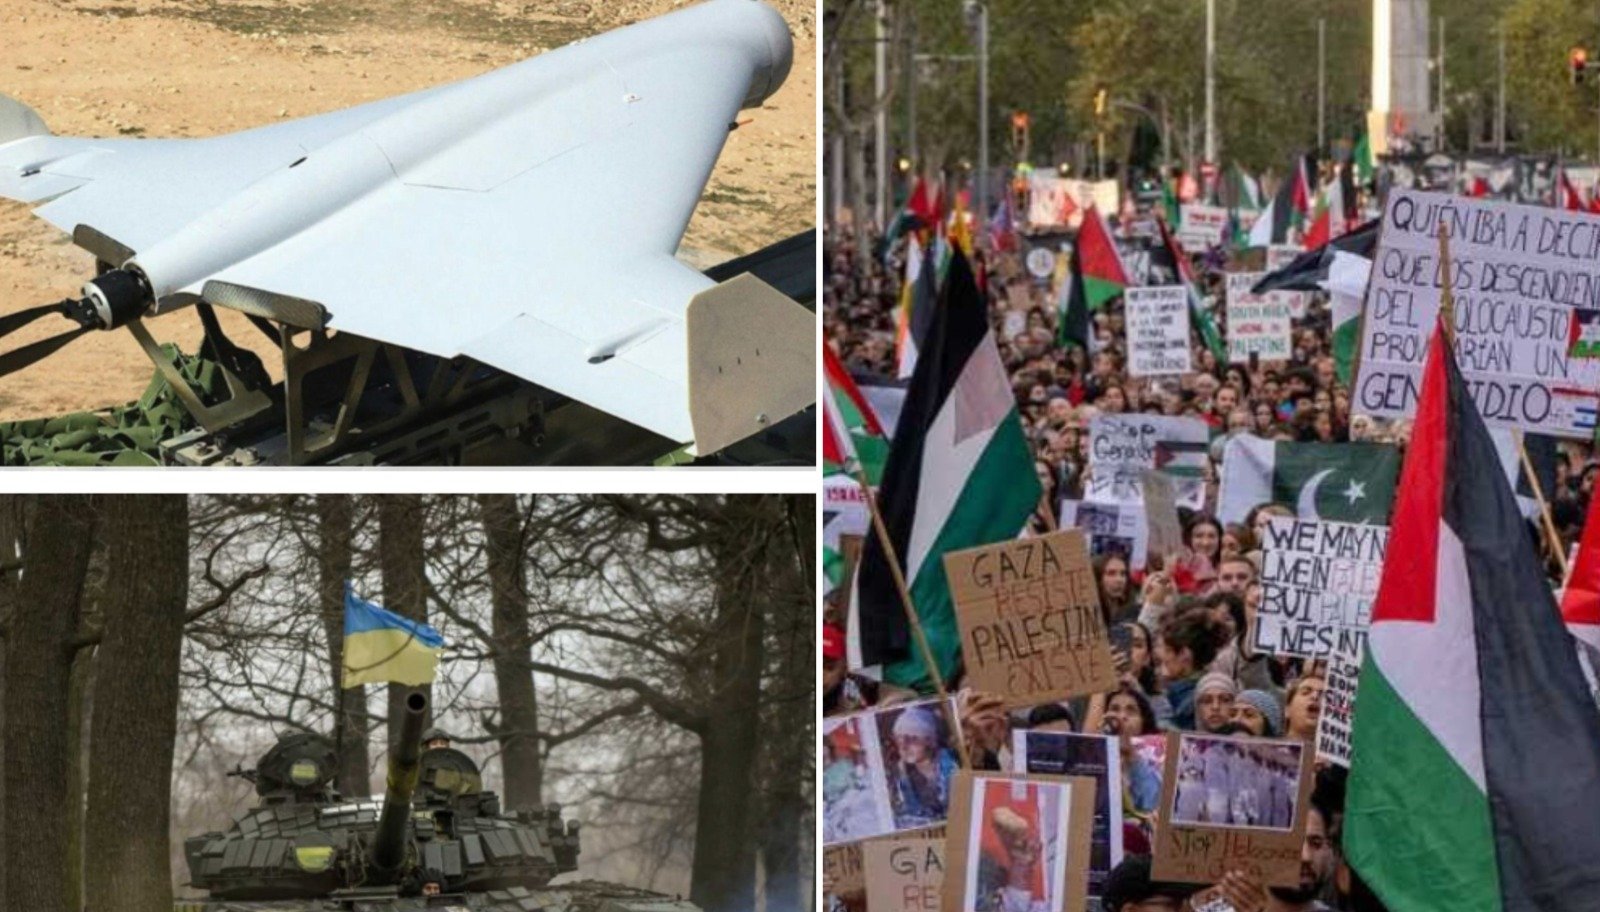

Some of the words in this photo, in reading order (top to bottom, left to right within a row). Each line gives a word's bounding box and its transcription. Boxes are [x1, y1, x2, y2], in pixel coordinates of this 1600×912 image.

[1392, 197, 1470, 240] QUIÉN
[1472, 208, 1507, 248] IBA
[1512, 214, 1529, 252] A
[1383, 248, 1431, 287] QUE
[1373, 287, 1418, 329] DEL
[1450, 294, 1569, 342] OLOCAUSTO
[1534, 343, 1568, 378] UN
[1361, 372, 1551, 424] GENIDIO
[1268, 520, 1317, 553] WE
[1319, 523, 1369, 559] MAY
[971, 541, 1061, 588] GAZA
[1259, 583, 1321, 623] BUT
